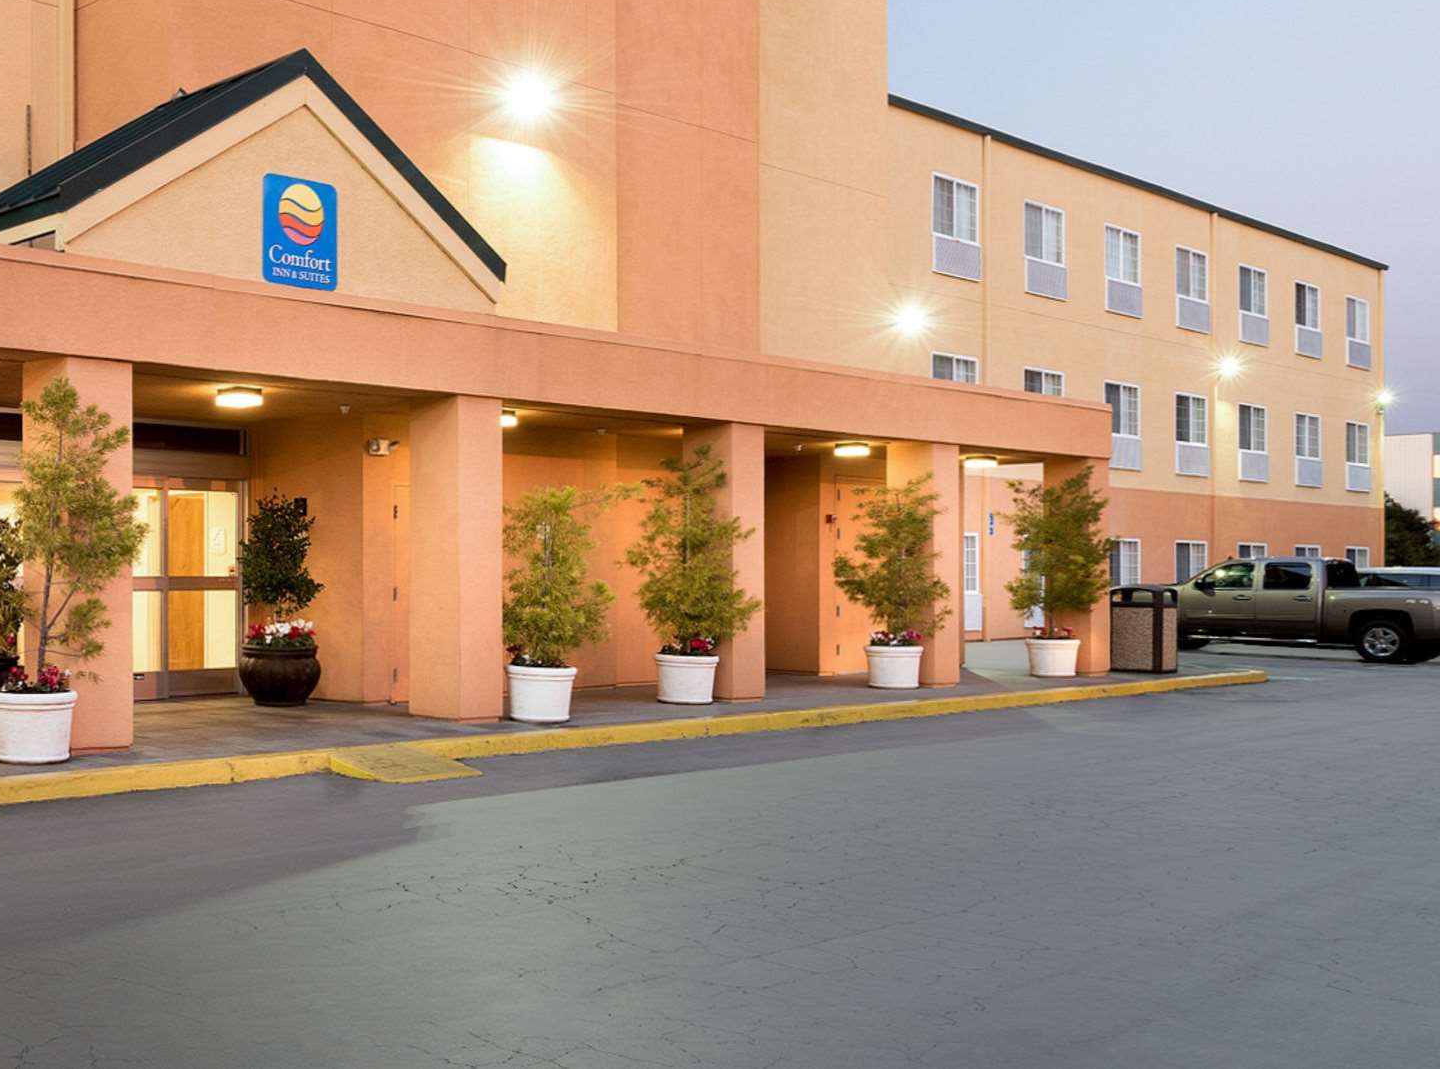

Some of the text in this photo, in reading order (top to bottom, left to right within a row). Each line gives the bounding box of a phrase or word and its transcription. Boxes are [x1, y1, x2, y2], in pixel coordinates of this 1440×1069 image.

[269, 244, 331, 271] Comfort
[272, 267, 291, 278] INN
[299, 271, 330, 284] SUITES
